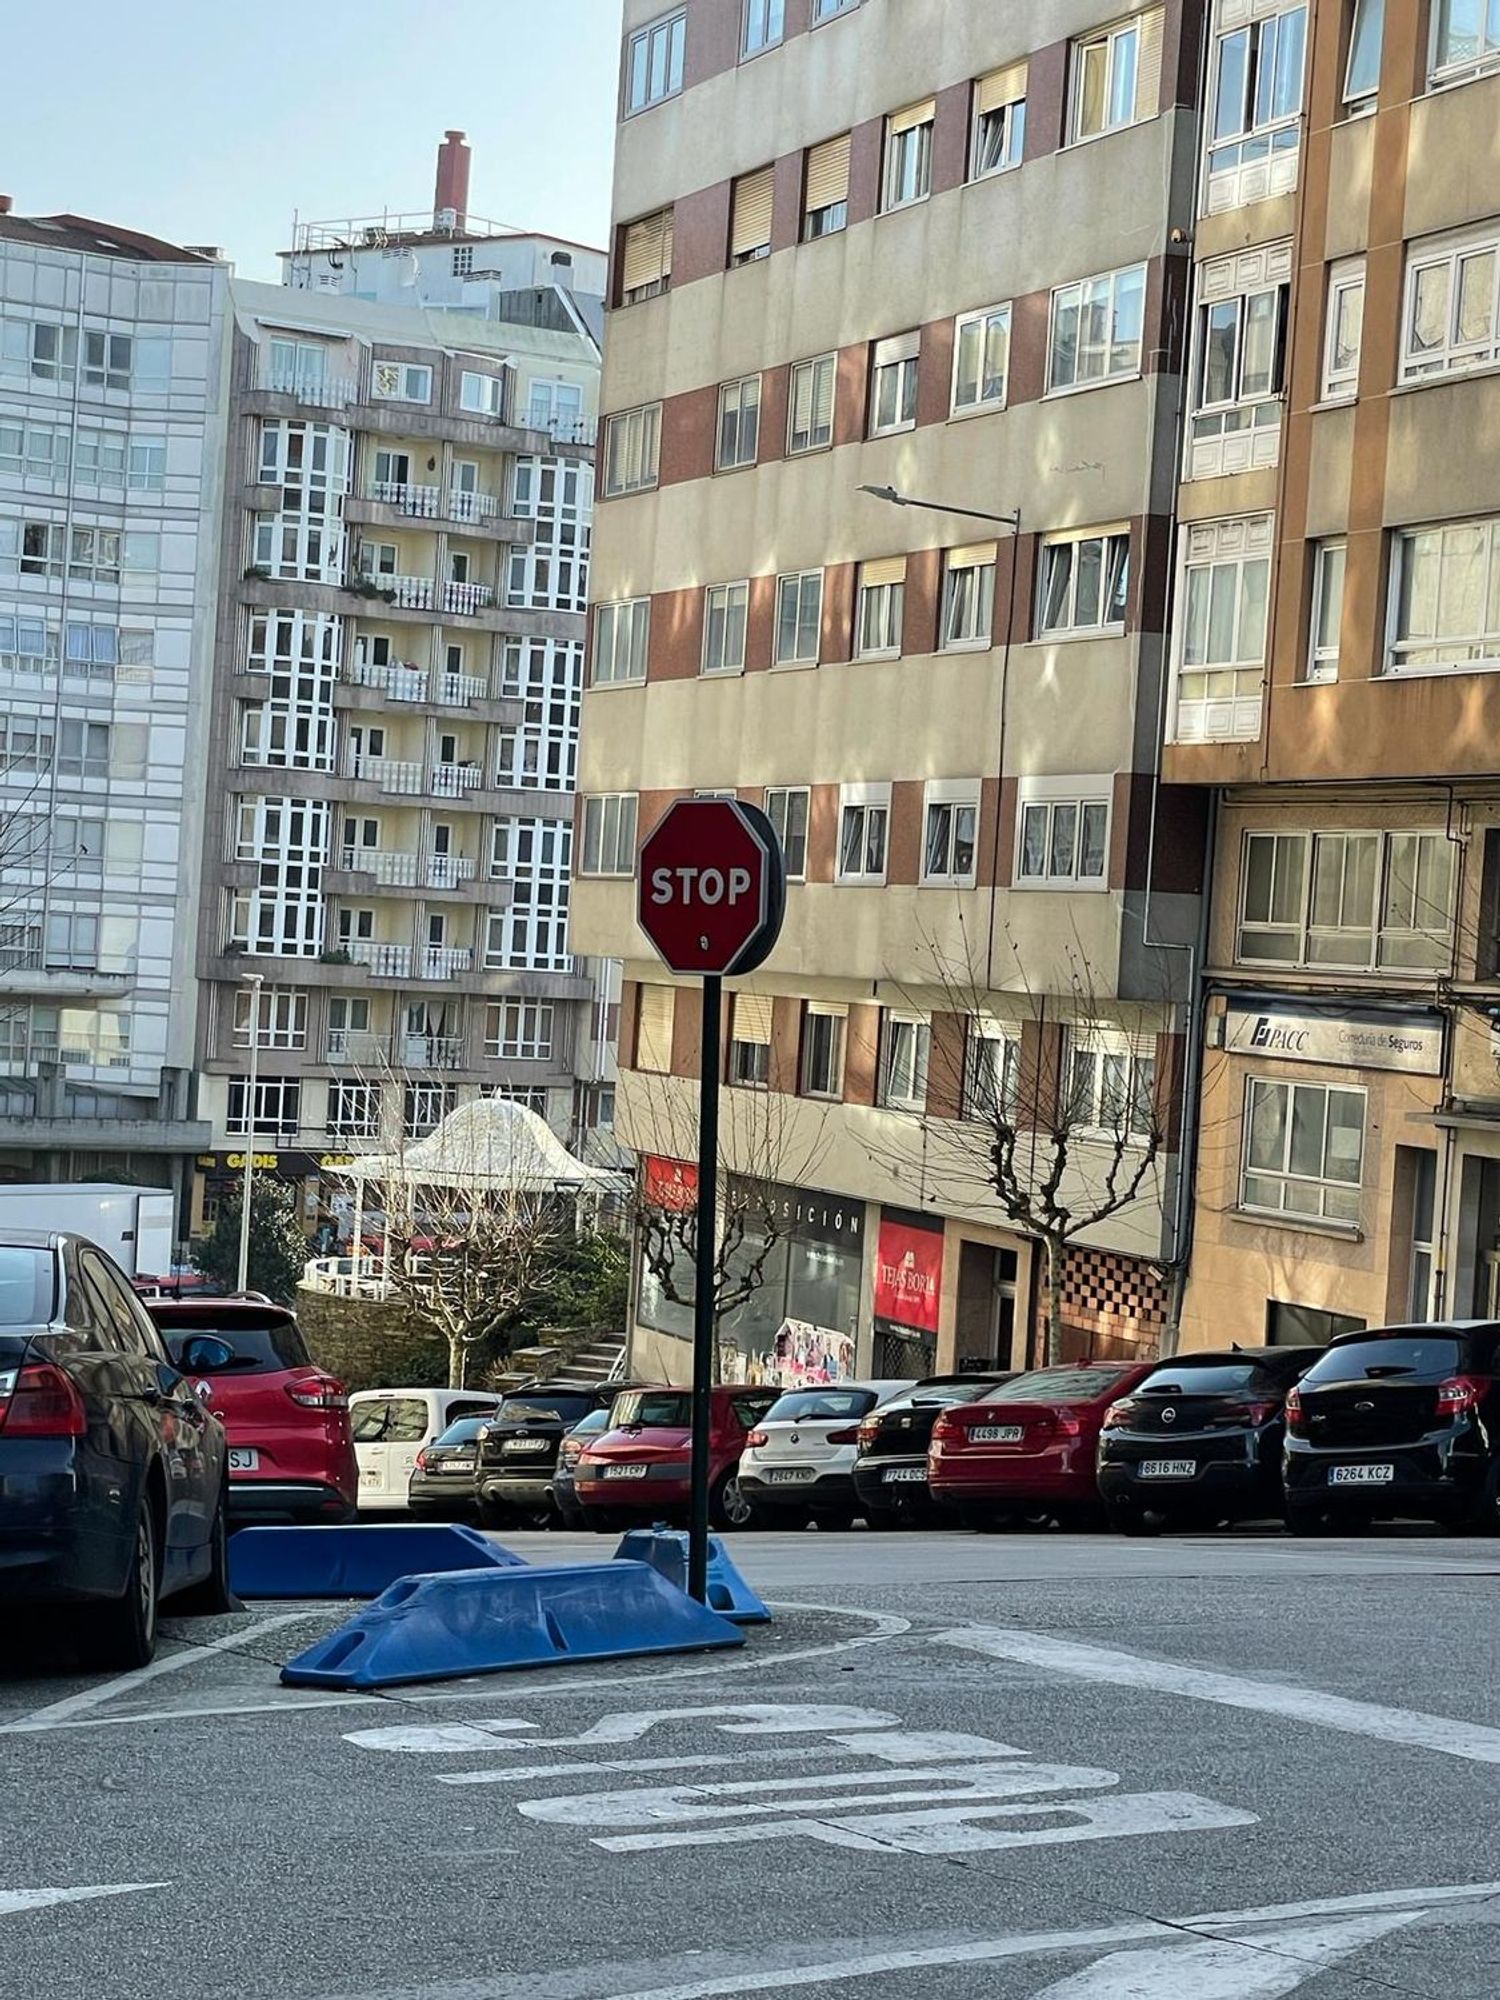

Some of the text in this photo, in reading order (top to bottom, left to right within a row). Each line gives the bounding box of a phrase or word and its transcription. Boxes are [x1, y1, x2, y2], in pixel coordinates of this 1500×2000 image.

[651, 867, 751, 905] STOP
[1268, 1028, 1310, 1051] PACC
[1388, 1034, 1423, 1053] Seguros
[882, 1264, 906, 1289] TEJAS
[230, 1451, 252, 1468] SJ
[1172, 1461, 1194, 1473] HNZ
[1336, 1466, 1390, 1480] 6264 KCZ
[341, 1703, 1261, 1855] STOP
